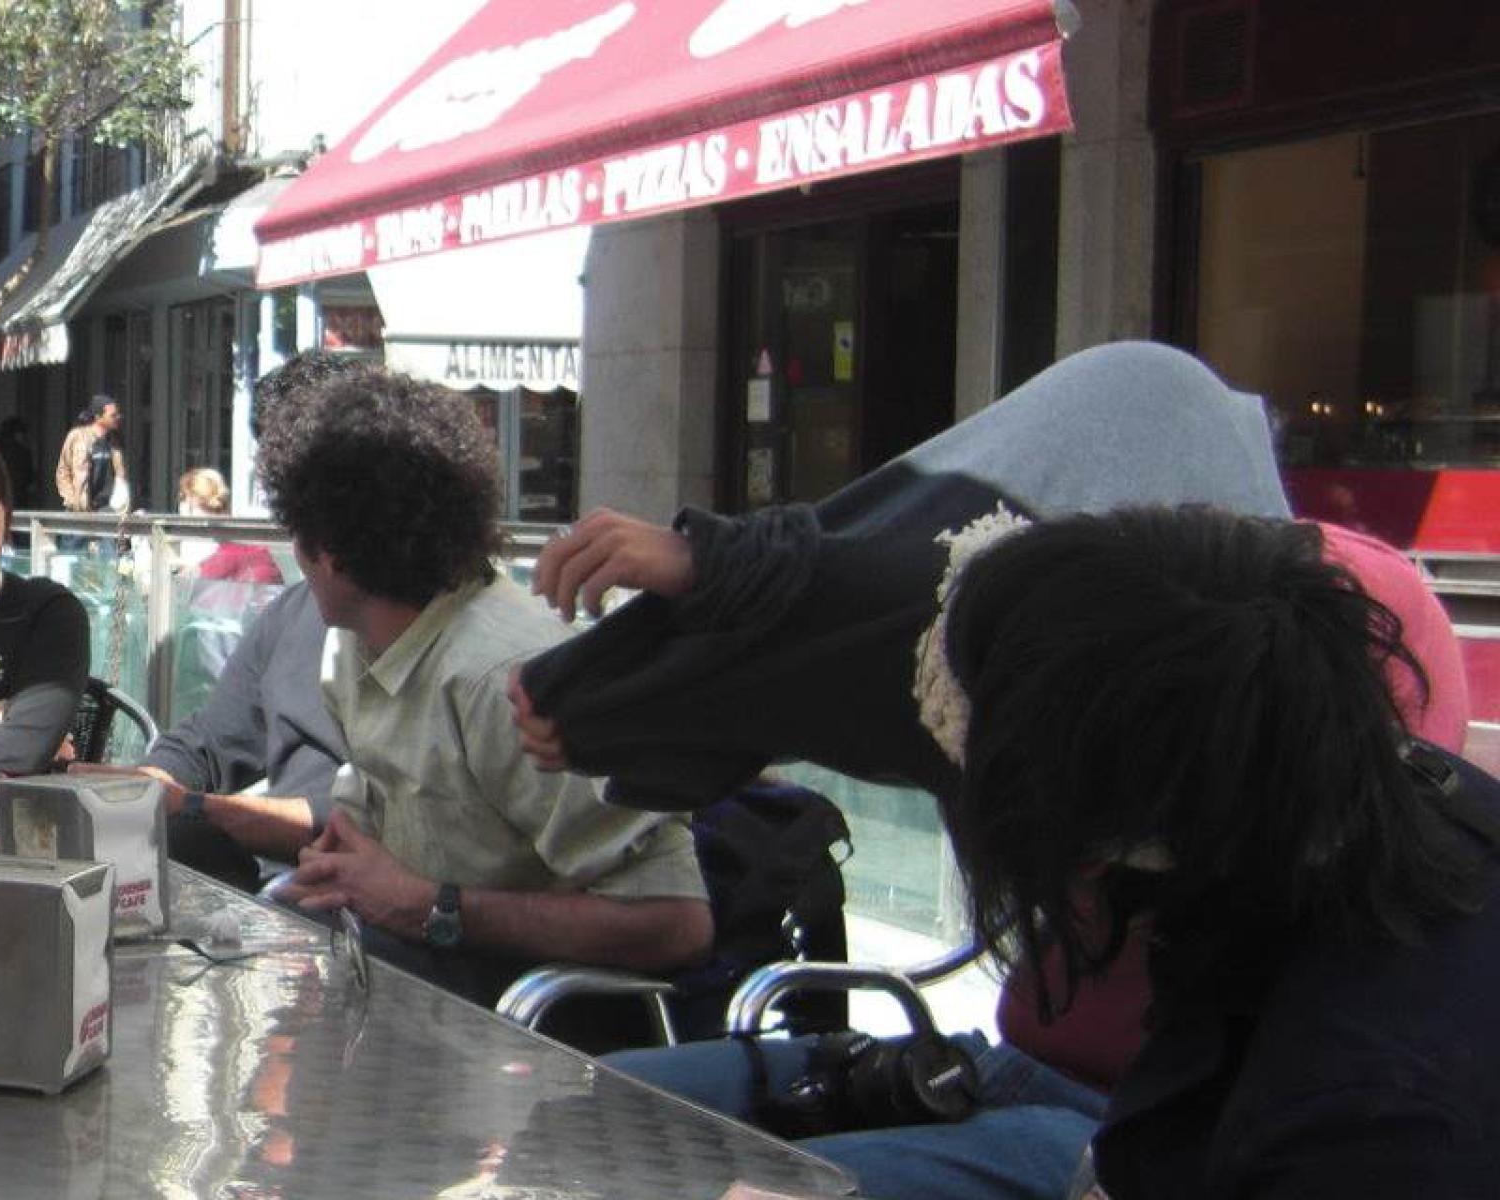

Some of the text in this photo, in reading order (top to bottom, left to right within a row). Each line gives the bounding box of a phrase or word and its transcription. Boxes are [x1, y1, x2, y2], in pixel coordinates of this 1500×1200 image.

[460, 168, 582, 245] PAELLAS
[602, 134, 727, 216] PIZZAS
[754, 50, 1045, 185] ENSALADAS
[445, 343, 578, 380] ALIMENTA
